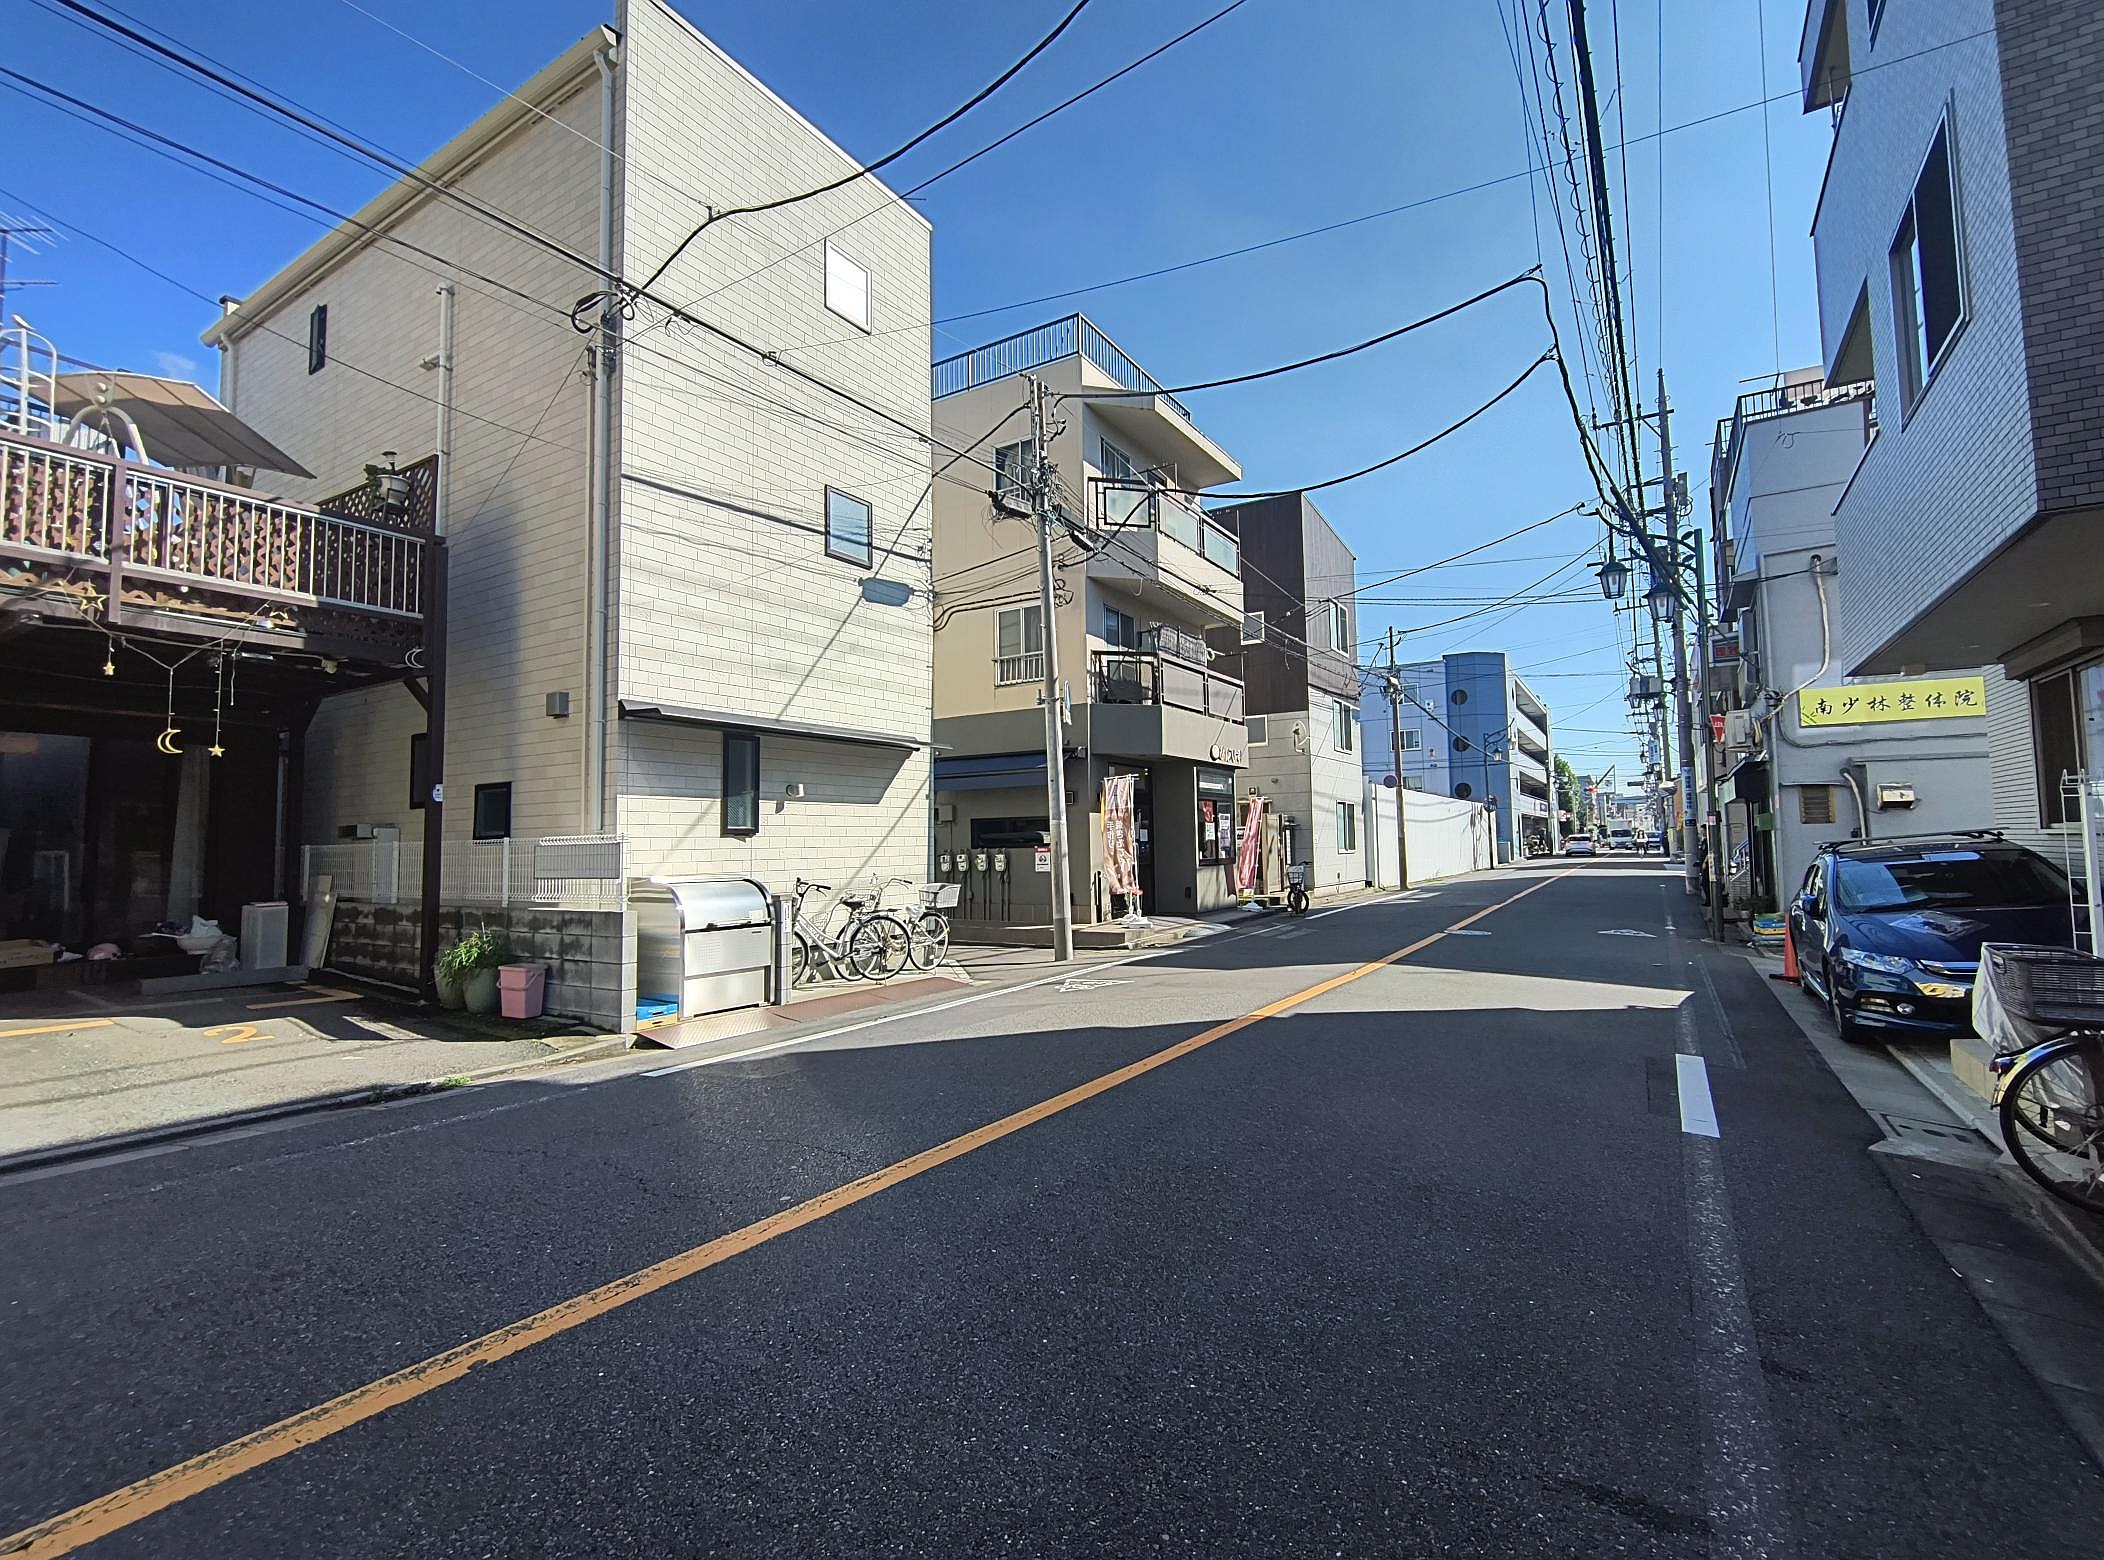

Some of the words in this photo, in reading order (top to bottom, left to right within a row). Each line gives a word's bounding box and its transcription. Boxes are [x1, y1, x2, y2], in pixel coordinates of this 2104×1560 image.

[1815, 689, 1978, 715] 南少林整体院
[202, 1026, 276, 1044] 2
